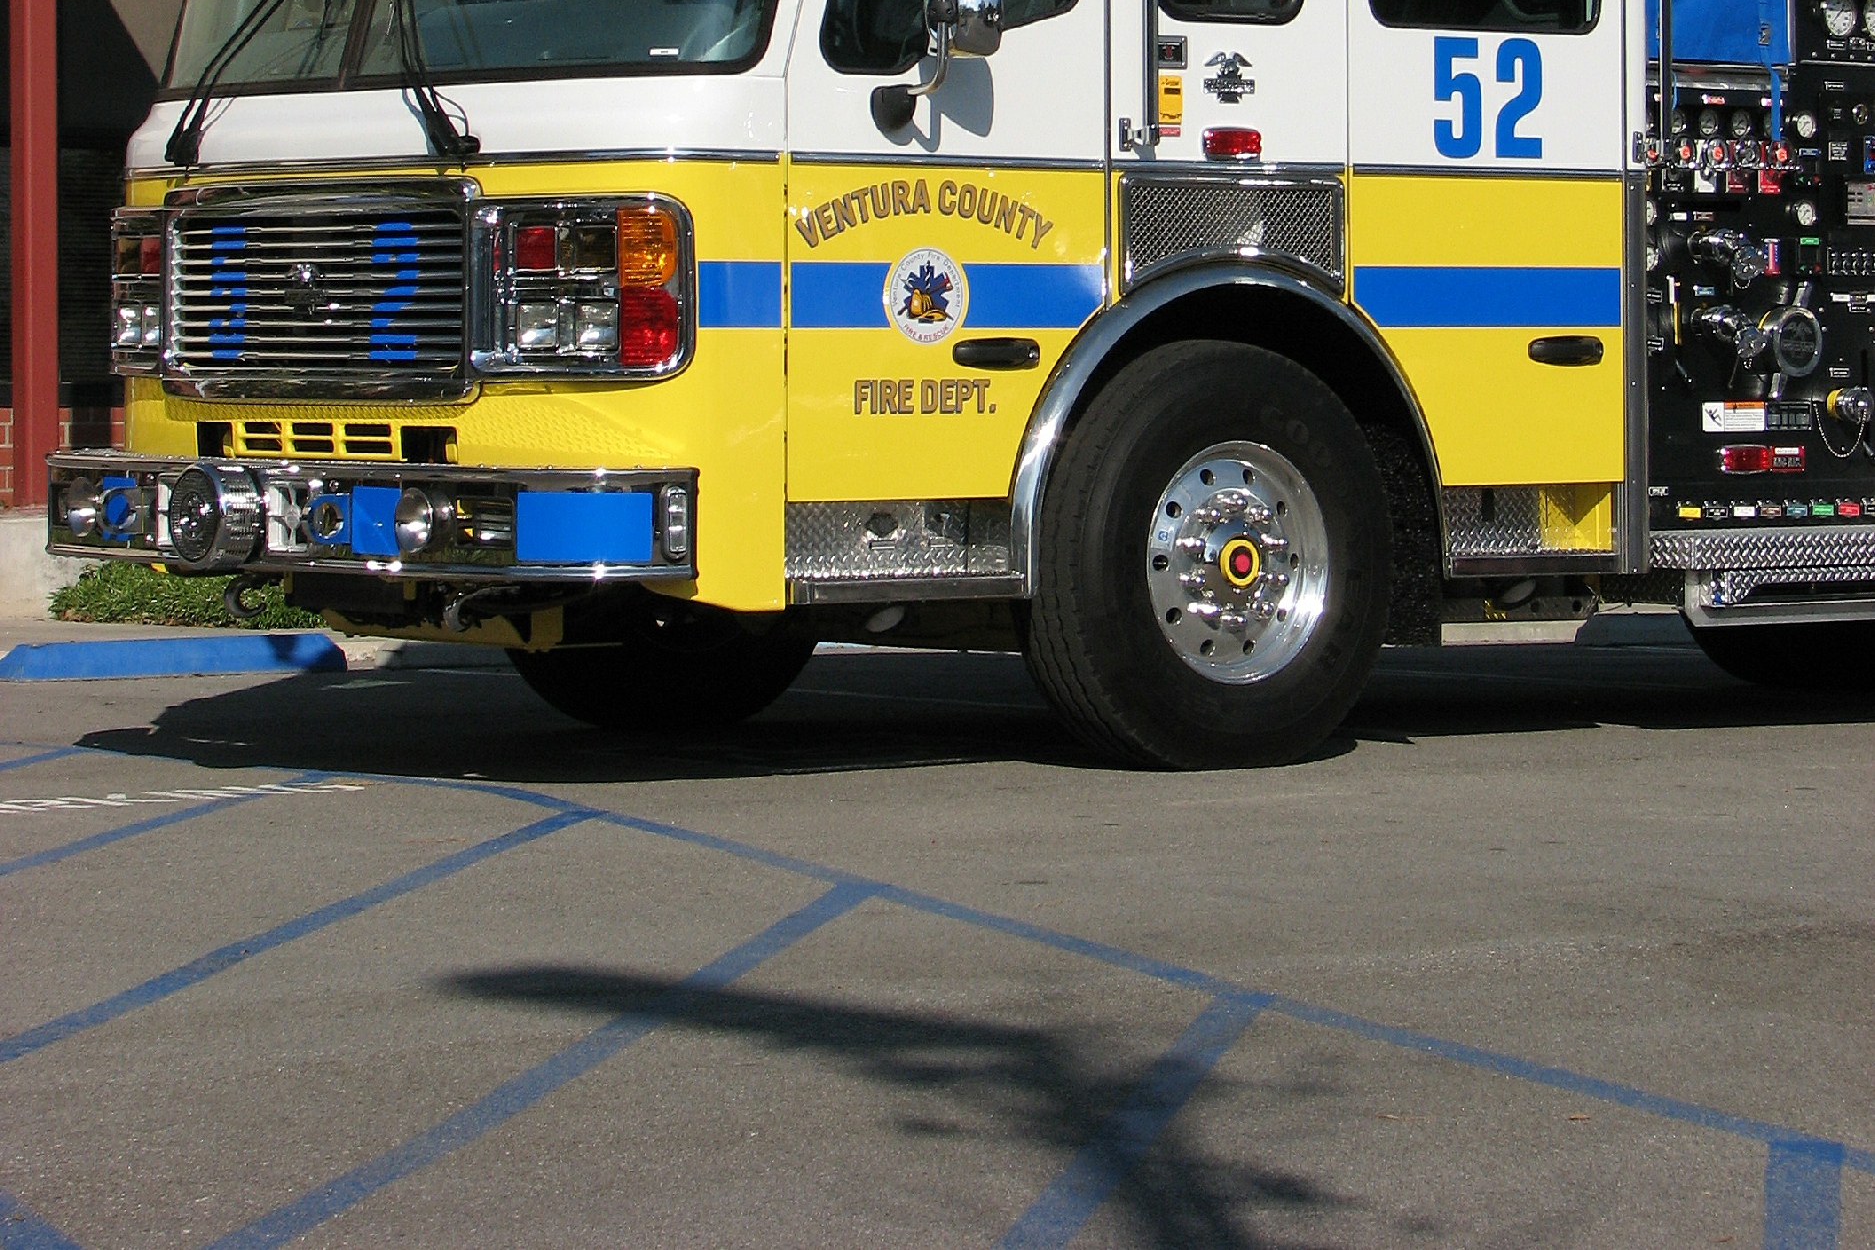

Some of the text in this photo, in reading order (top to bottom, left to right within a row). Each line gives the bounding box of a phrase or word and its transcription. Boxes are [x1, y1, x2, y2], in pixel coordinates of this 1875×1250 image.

[1433, 36, 1543, 159] 52
[795, 179, 1054, 249] VENTURA COUNTY
[854, 379, 997, 414] FIRE DEPT.
